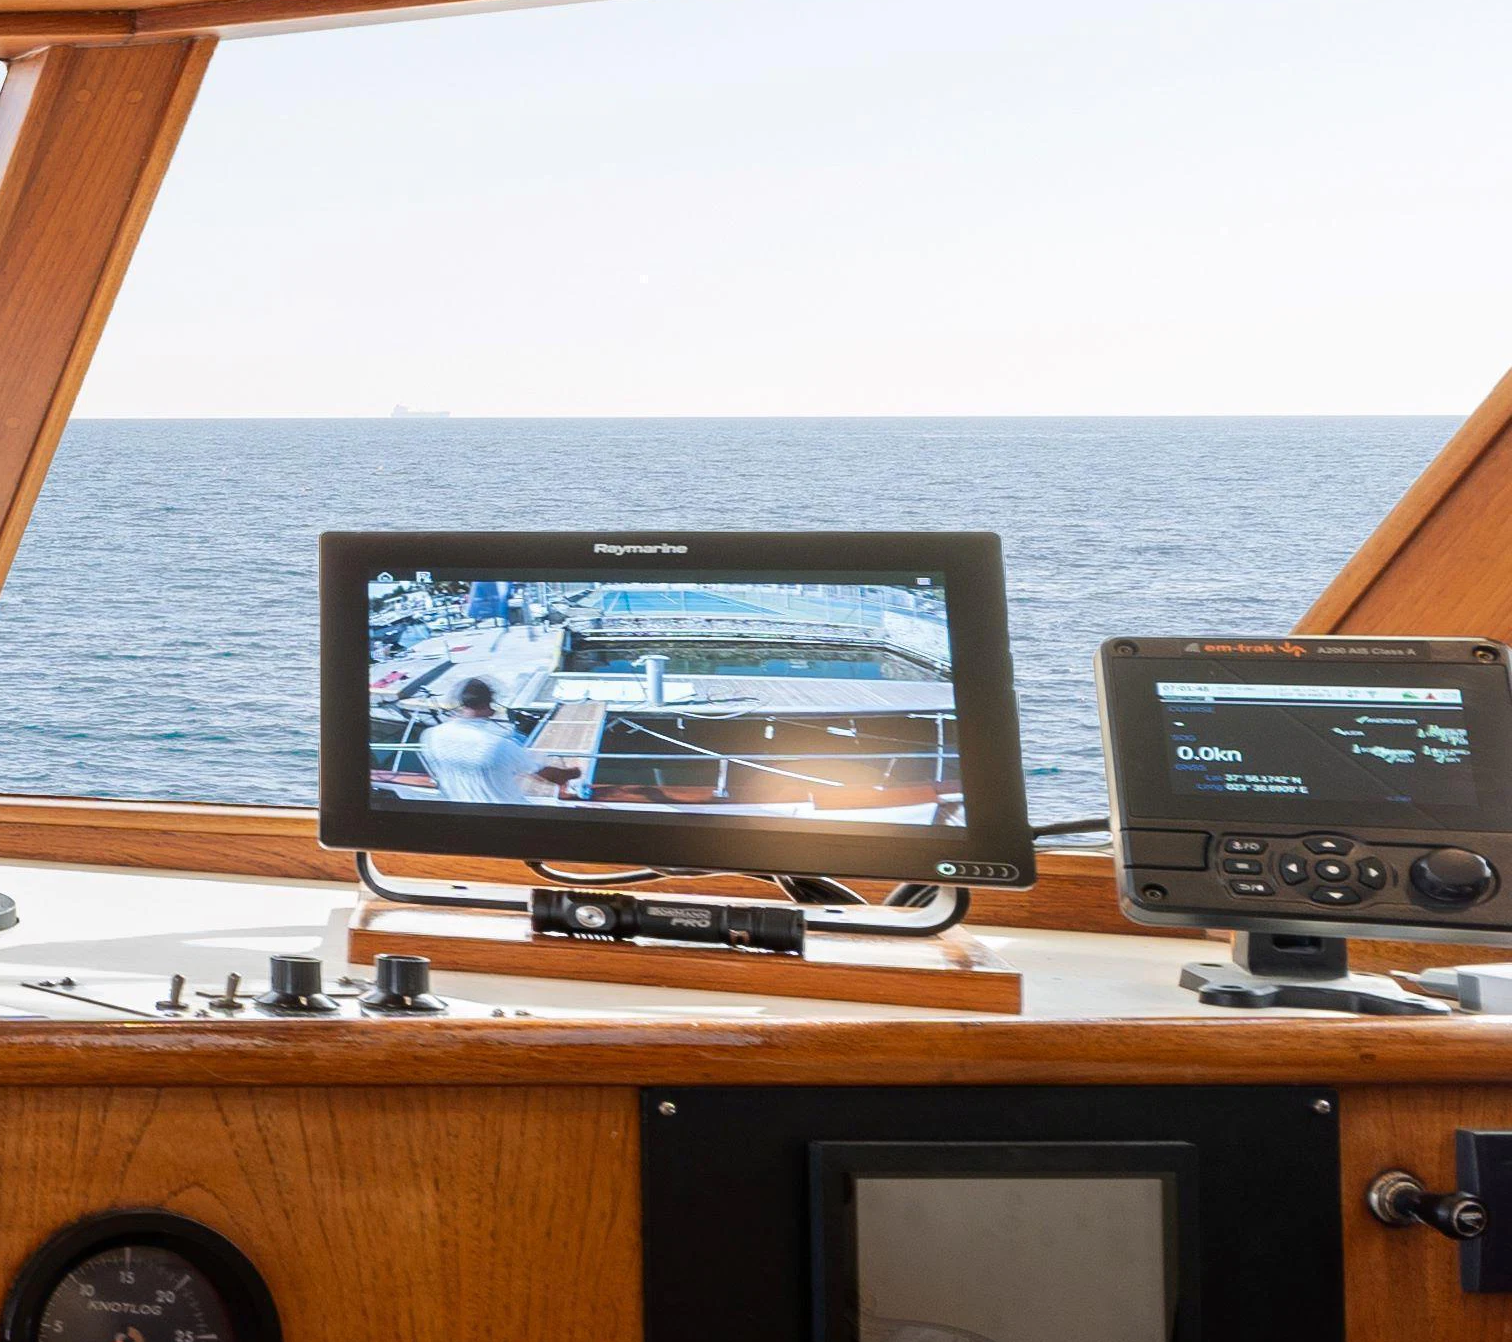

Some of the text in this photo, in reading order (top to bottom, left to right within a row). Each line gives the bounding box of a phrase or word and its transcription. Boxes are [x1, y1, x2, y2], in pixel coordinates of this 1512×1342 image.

[593, 543, 689, 556] Raymarine
[1204, 643, 1275, 653] em-trak
[1371, 646, 1406, 656] Class
[1407, 648, 1416, 657] A
[1176, 745, 1243, 763] 0.0kn
[670, 917, 712, 928] PRO
[119, 1270, 135, 1285] 15
[155, 1289, 176, 1304] 20
[86, 1300, 163, 1316] KNOTLOG
[53, 1319, 64, 1333] 5
